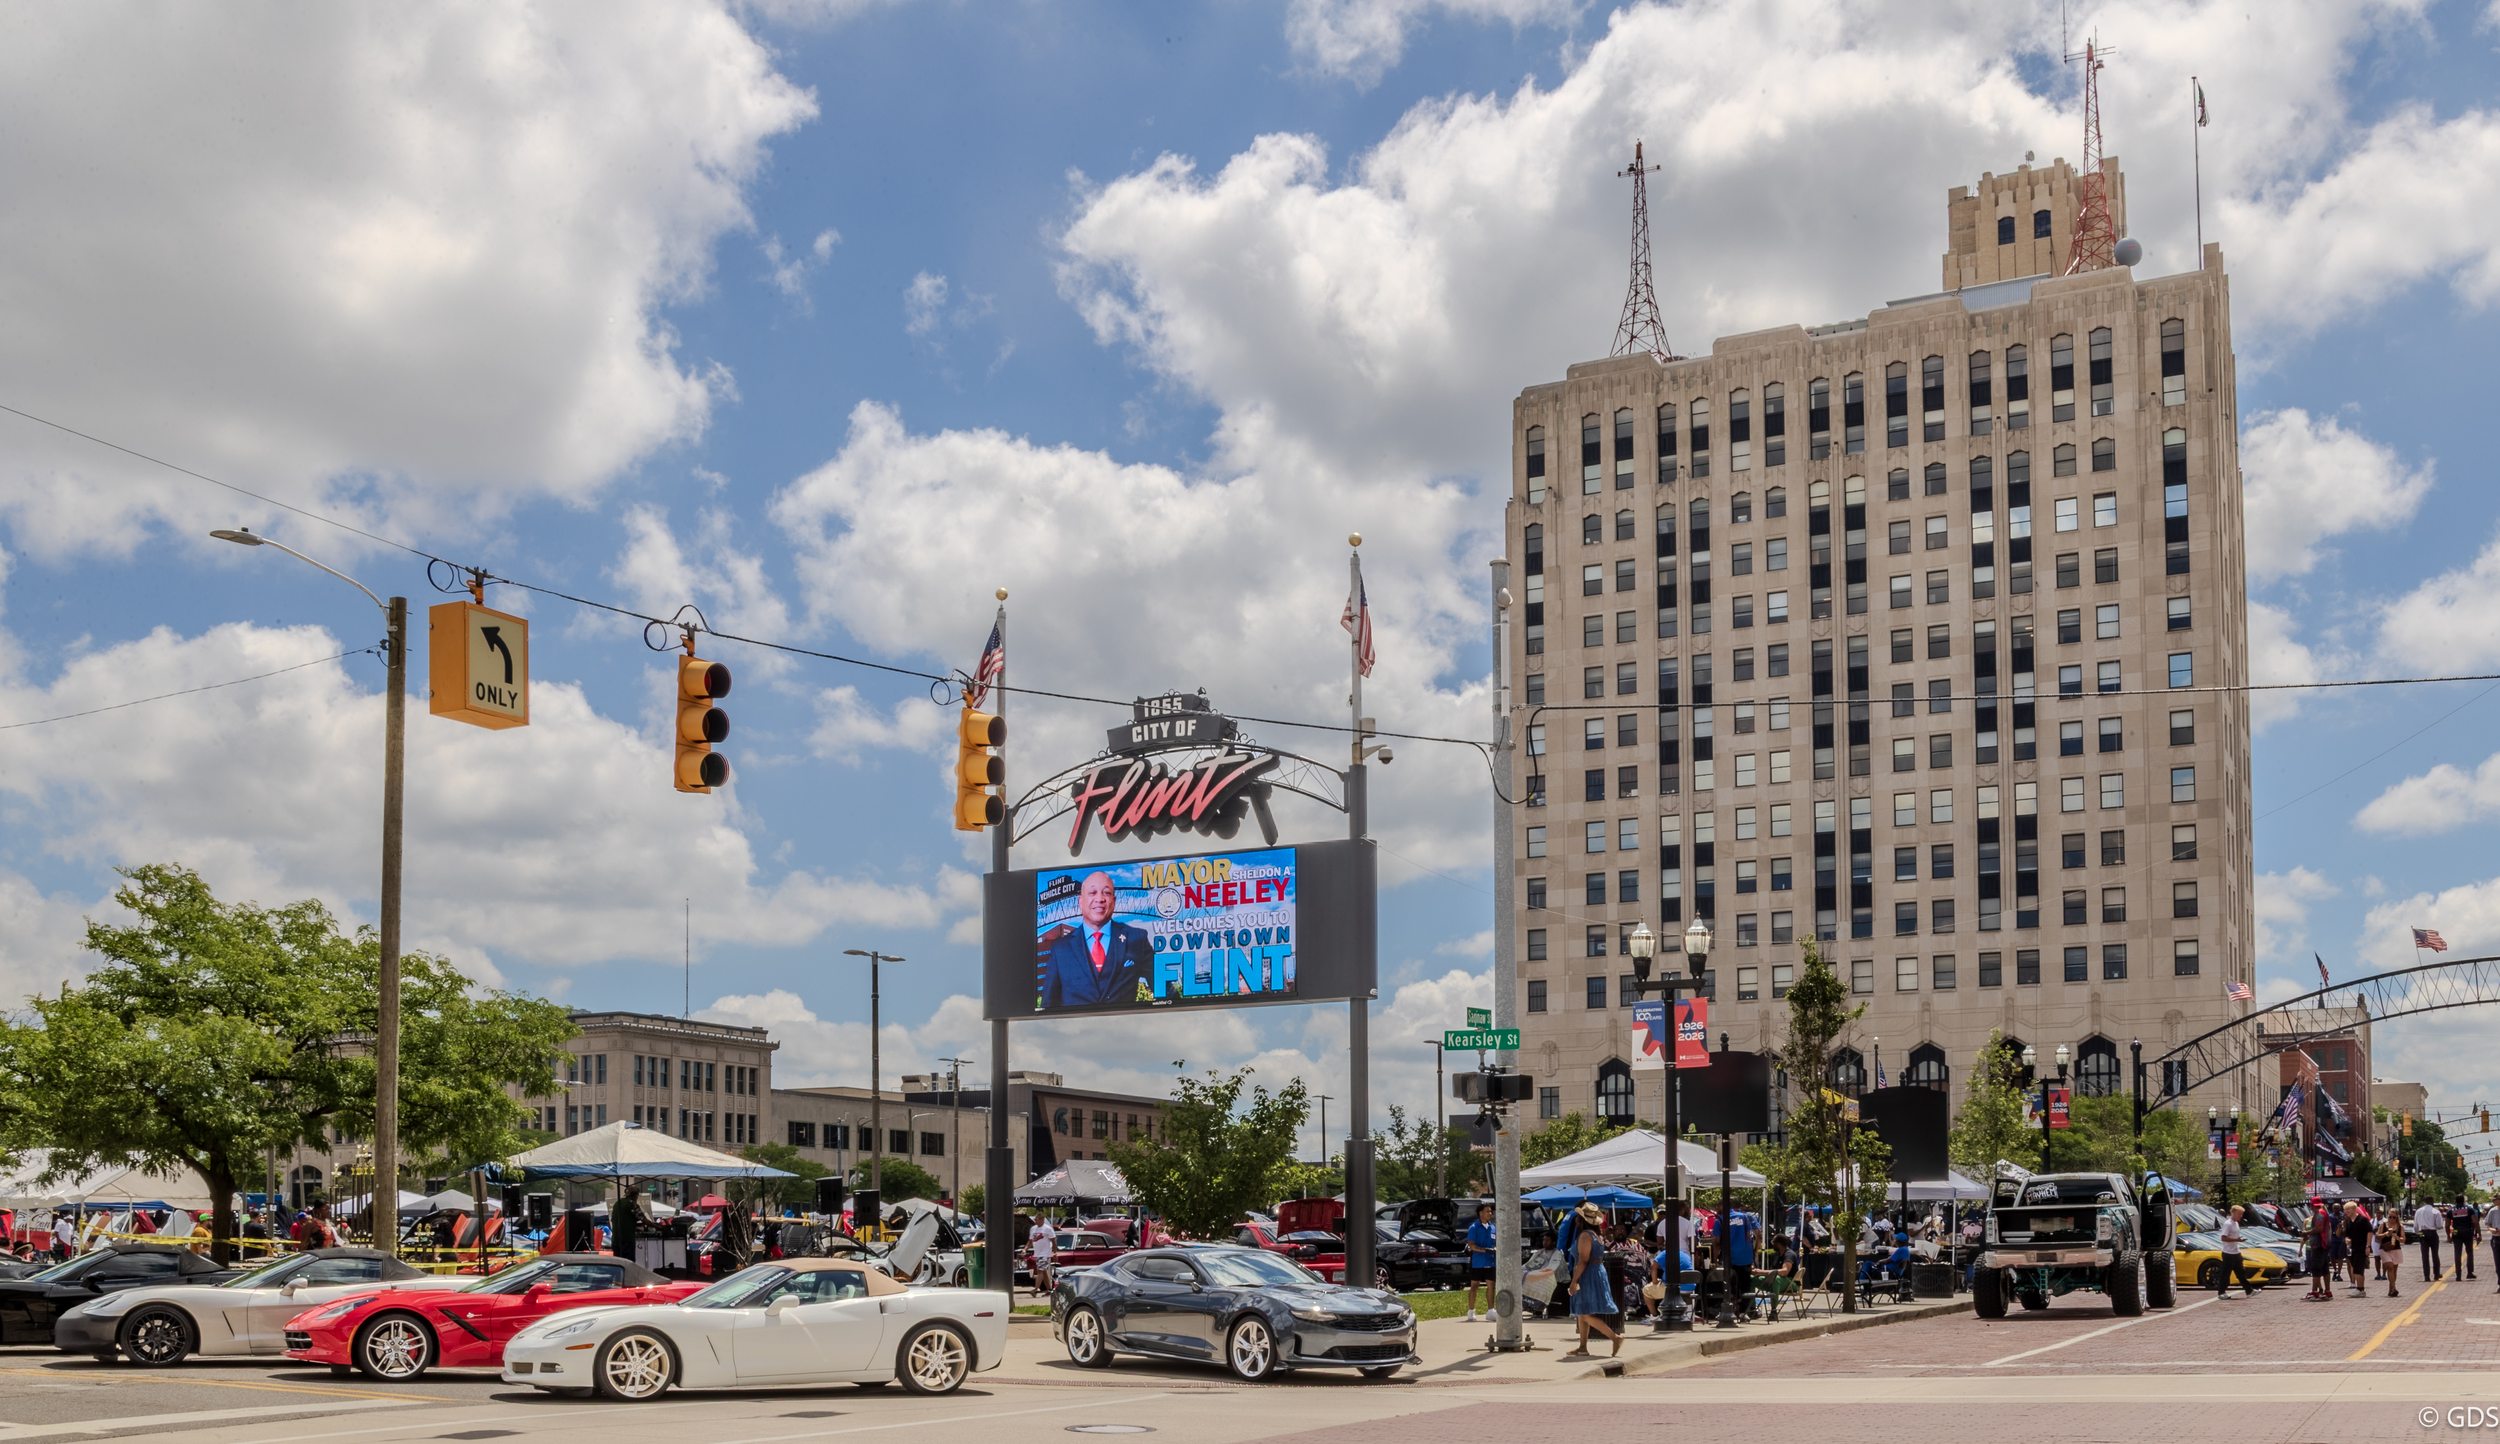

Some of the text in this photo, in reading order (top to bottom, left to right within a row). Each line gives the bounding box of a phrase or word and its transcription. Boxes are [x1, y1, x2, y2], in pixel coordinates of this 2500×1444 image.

[475, 681, 518, 709] ONLY
[1144, 697, 1182, 717] 1855
[1132, 719, 1196, 743] CITY OF
[1067, 746, 1273, 849] Flint
[1048, 876, 1065, 887] FLINT
[1142, 859, 1232, 889] MAYOR
[1233, 867, 1278, 880] SHELDON
[1039, 882, 1076, 901] VEHICLE CITY
[1184, 878, 1290, 909] NEELEY
[1152, 910, 1289, 934] WELCOMES YOU TO
[1153, 925, 1290, 952] DOWNTOWN
[1153, 944, 1292, 998] FLINT
[1677, 1032, 1705, 1041] 2026
[1678, 1022, 1704, 1031] 1926
[1447, 1032, 1518, 1049] Kearsley St
